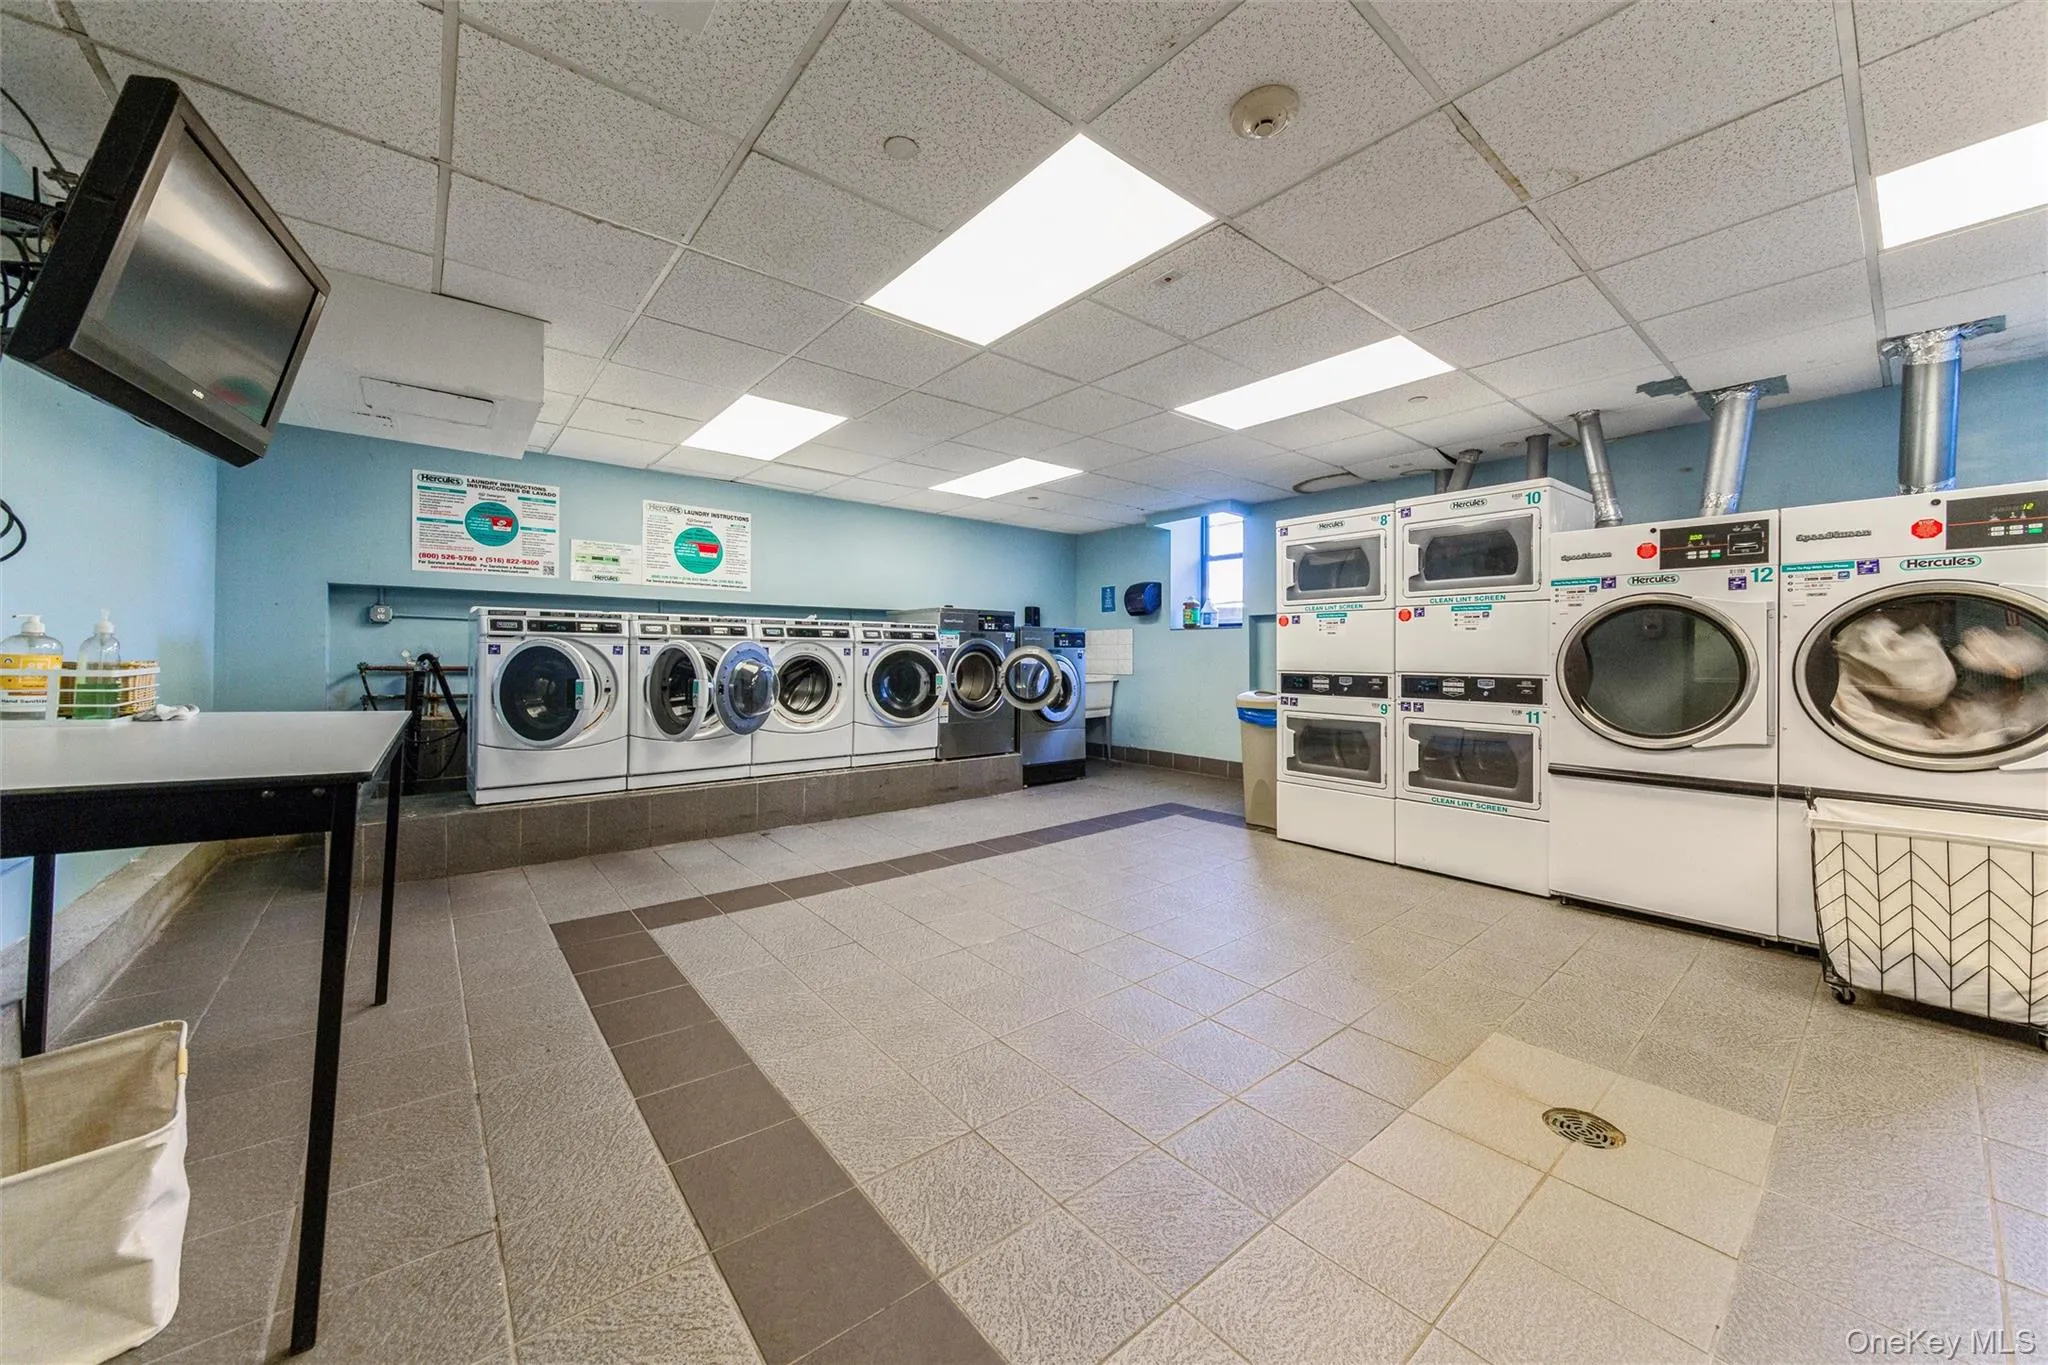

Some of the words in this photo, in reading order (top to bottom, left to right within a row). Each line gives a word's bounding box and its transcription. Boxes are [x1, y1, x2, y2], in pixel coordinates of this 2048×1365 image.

[421, 474, 460, 485] Hercules
[467, 478, 498, 486] LAUNDRY
[499, 482, 546, 492] INSTRUCTIONS
[466, 483, 520, 494] INSTRUCCIONES
[532, 490, 557, 498] LAVADO
[1452, 498, 1485, 509] Hercules
[1525, 491, 1541, 505] 10
[648, 503, 681, 514] Hercules
[683, 508, 710, 518] LAUNDRY
[710, 513, 749, 523] INSTRUCTIONS
[1380, 514, 1388, 526] 8
[1318, 520, 1344, 529] Hercules
[418, 552, 439, 561] (800)
[440, 554, 477, 562] 526-5760
[485, 556, 505, 565] (516)
[1906, 556, 1976, 569] Hercules
[594, 574, 618, 582] Hercules
[1631, 573, 1676, 585] Hercules
[1750, 566, 1774, 583] 12
[1474, 594, 1507, 602] SCREEN
[1380, 703, 1388, 715] 9
[1525, 710, 1540, 724] 11
[1431, 796, 1456, 805] CLEAN
[1456, 800, 1474, 808] LINT
[1475, 802, 1508, 813] SCREEN
